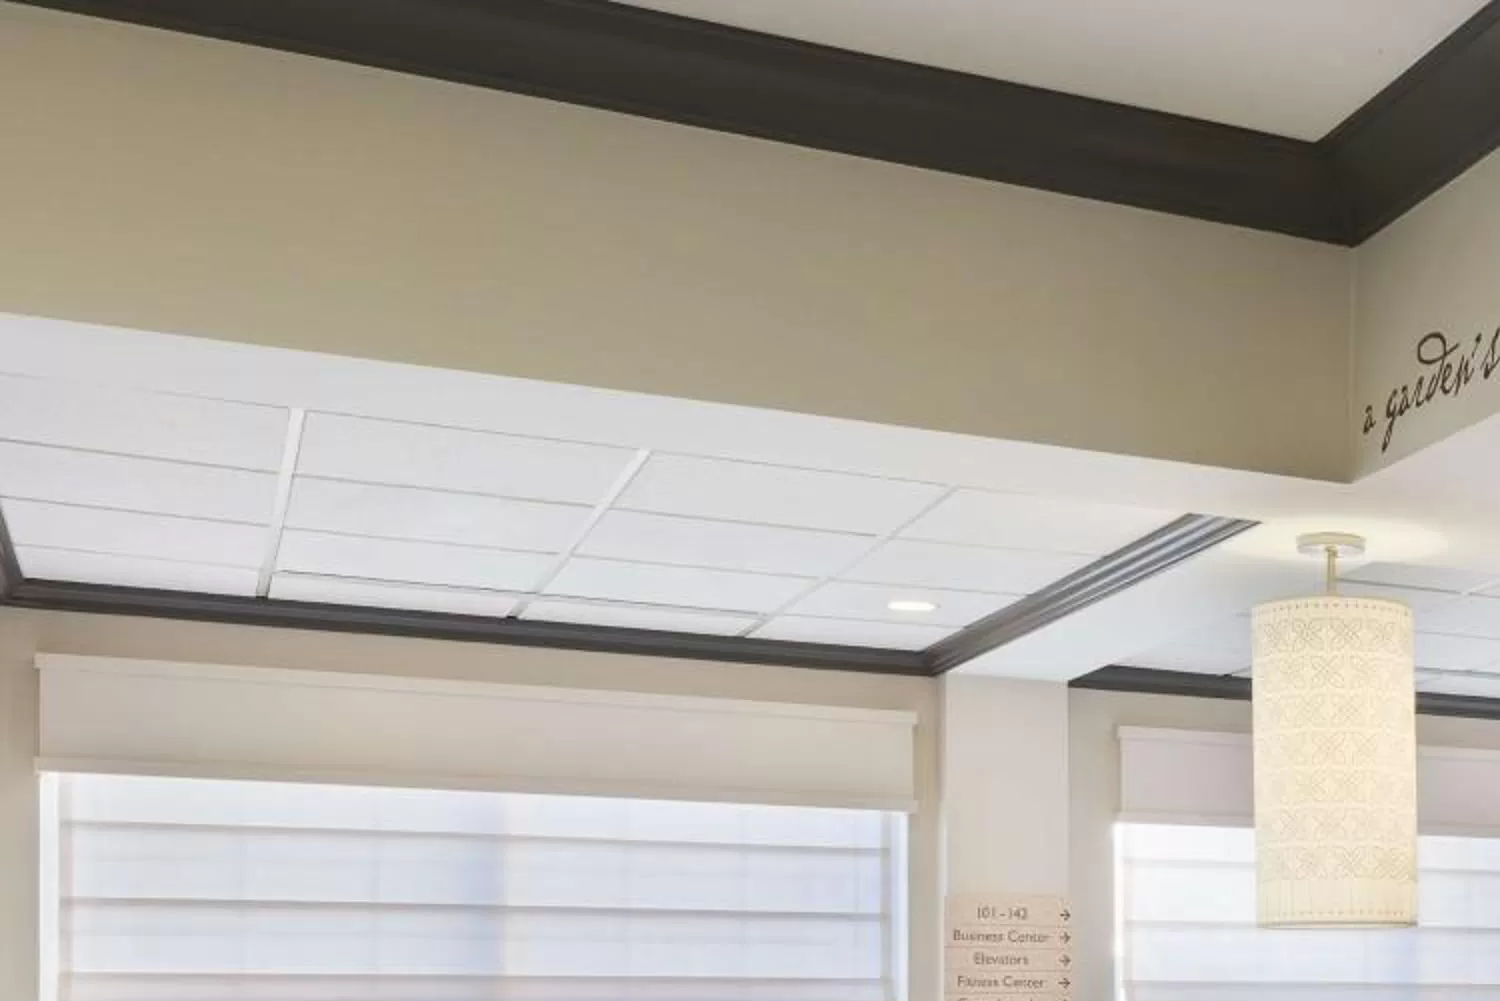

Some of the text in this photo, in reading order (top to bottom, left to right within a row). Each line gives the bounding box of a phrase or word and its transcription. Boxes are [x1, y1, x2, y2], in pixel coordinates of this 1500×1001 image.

[1362, 404, 1377, 435] a
[1381, 330, 1500, 453] garden's
[953, 929, 1050, 943] Business Center
[974, 951, 1029, 965] Elevators
[957, 975, 1045, 989] Fitness Center
